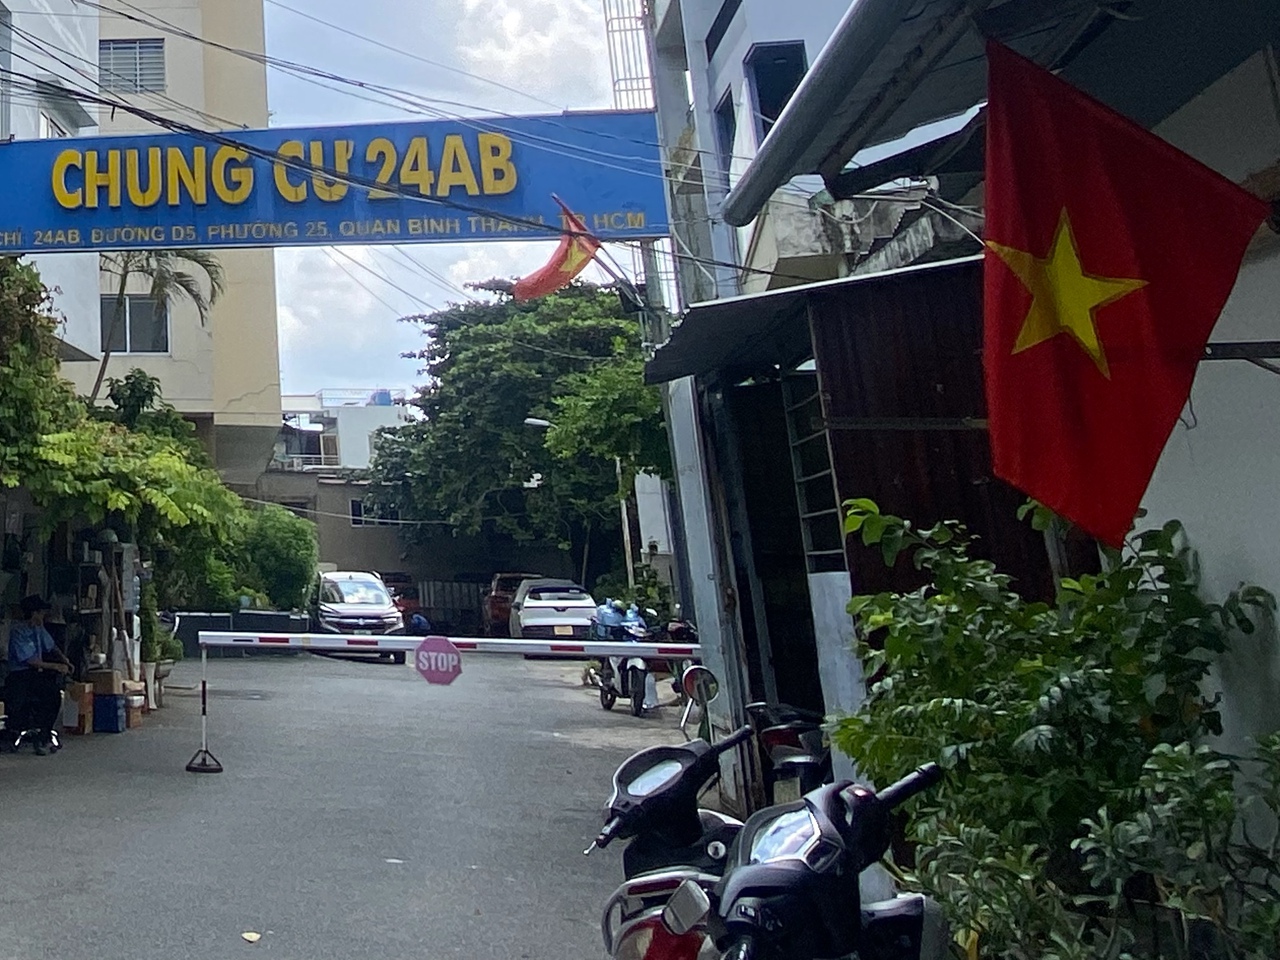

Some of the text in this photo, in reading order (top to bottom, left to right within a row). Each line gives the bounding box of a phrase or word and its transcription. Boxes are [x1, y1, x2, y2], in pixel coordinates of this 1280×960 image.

[52, 132, 518, 209] CHUNG CƯ 24AB
[593, 211, 645, 229] HCM
[418, 651, 459, 672] STOP
